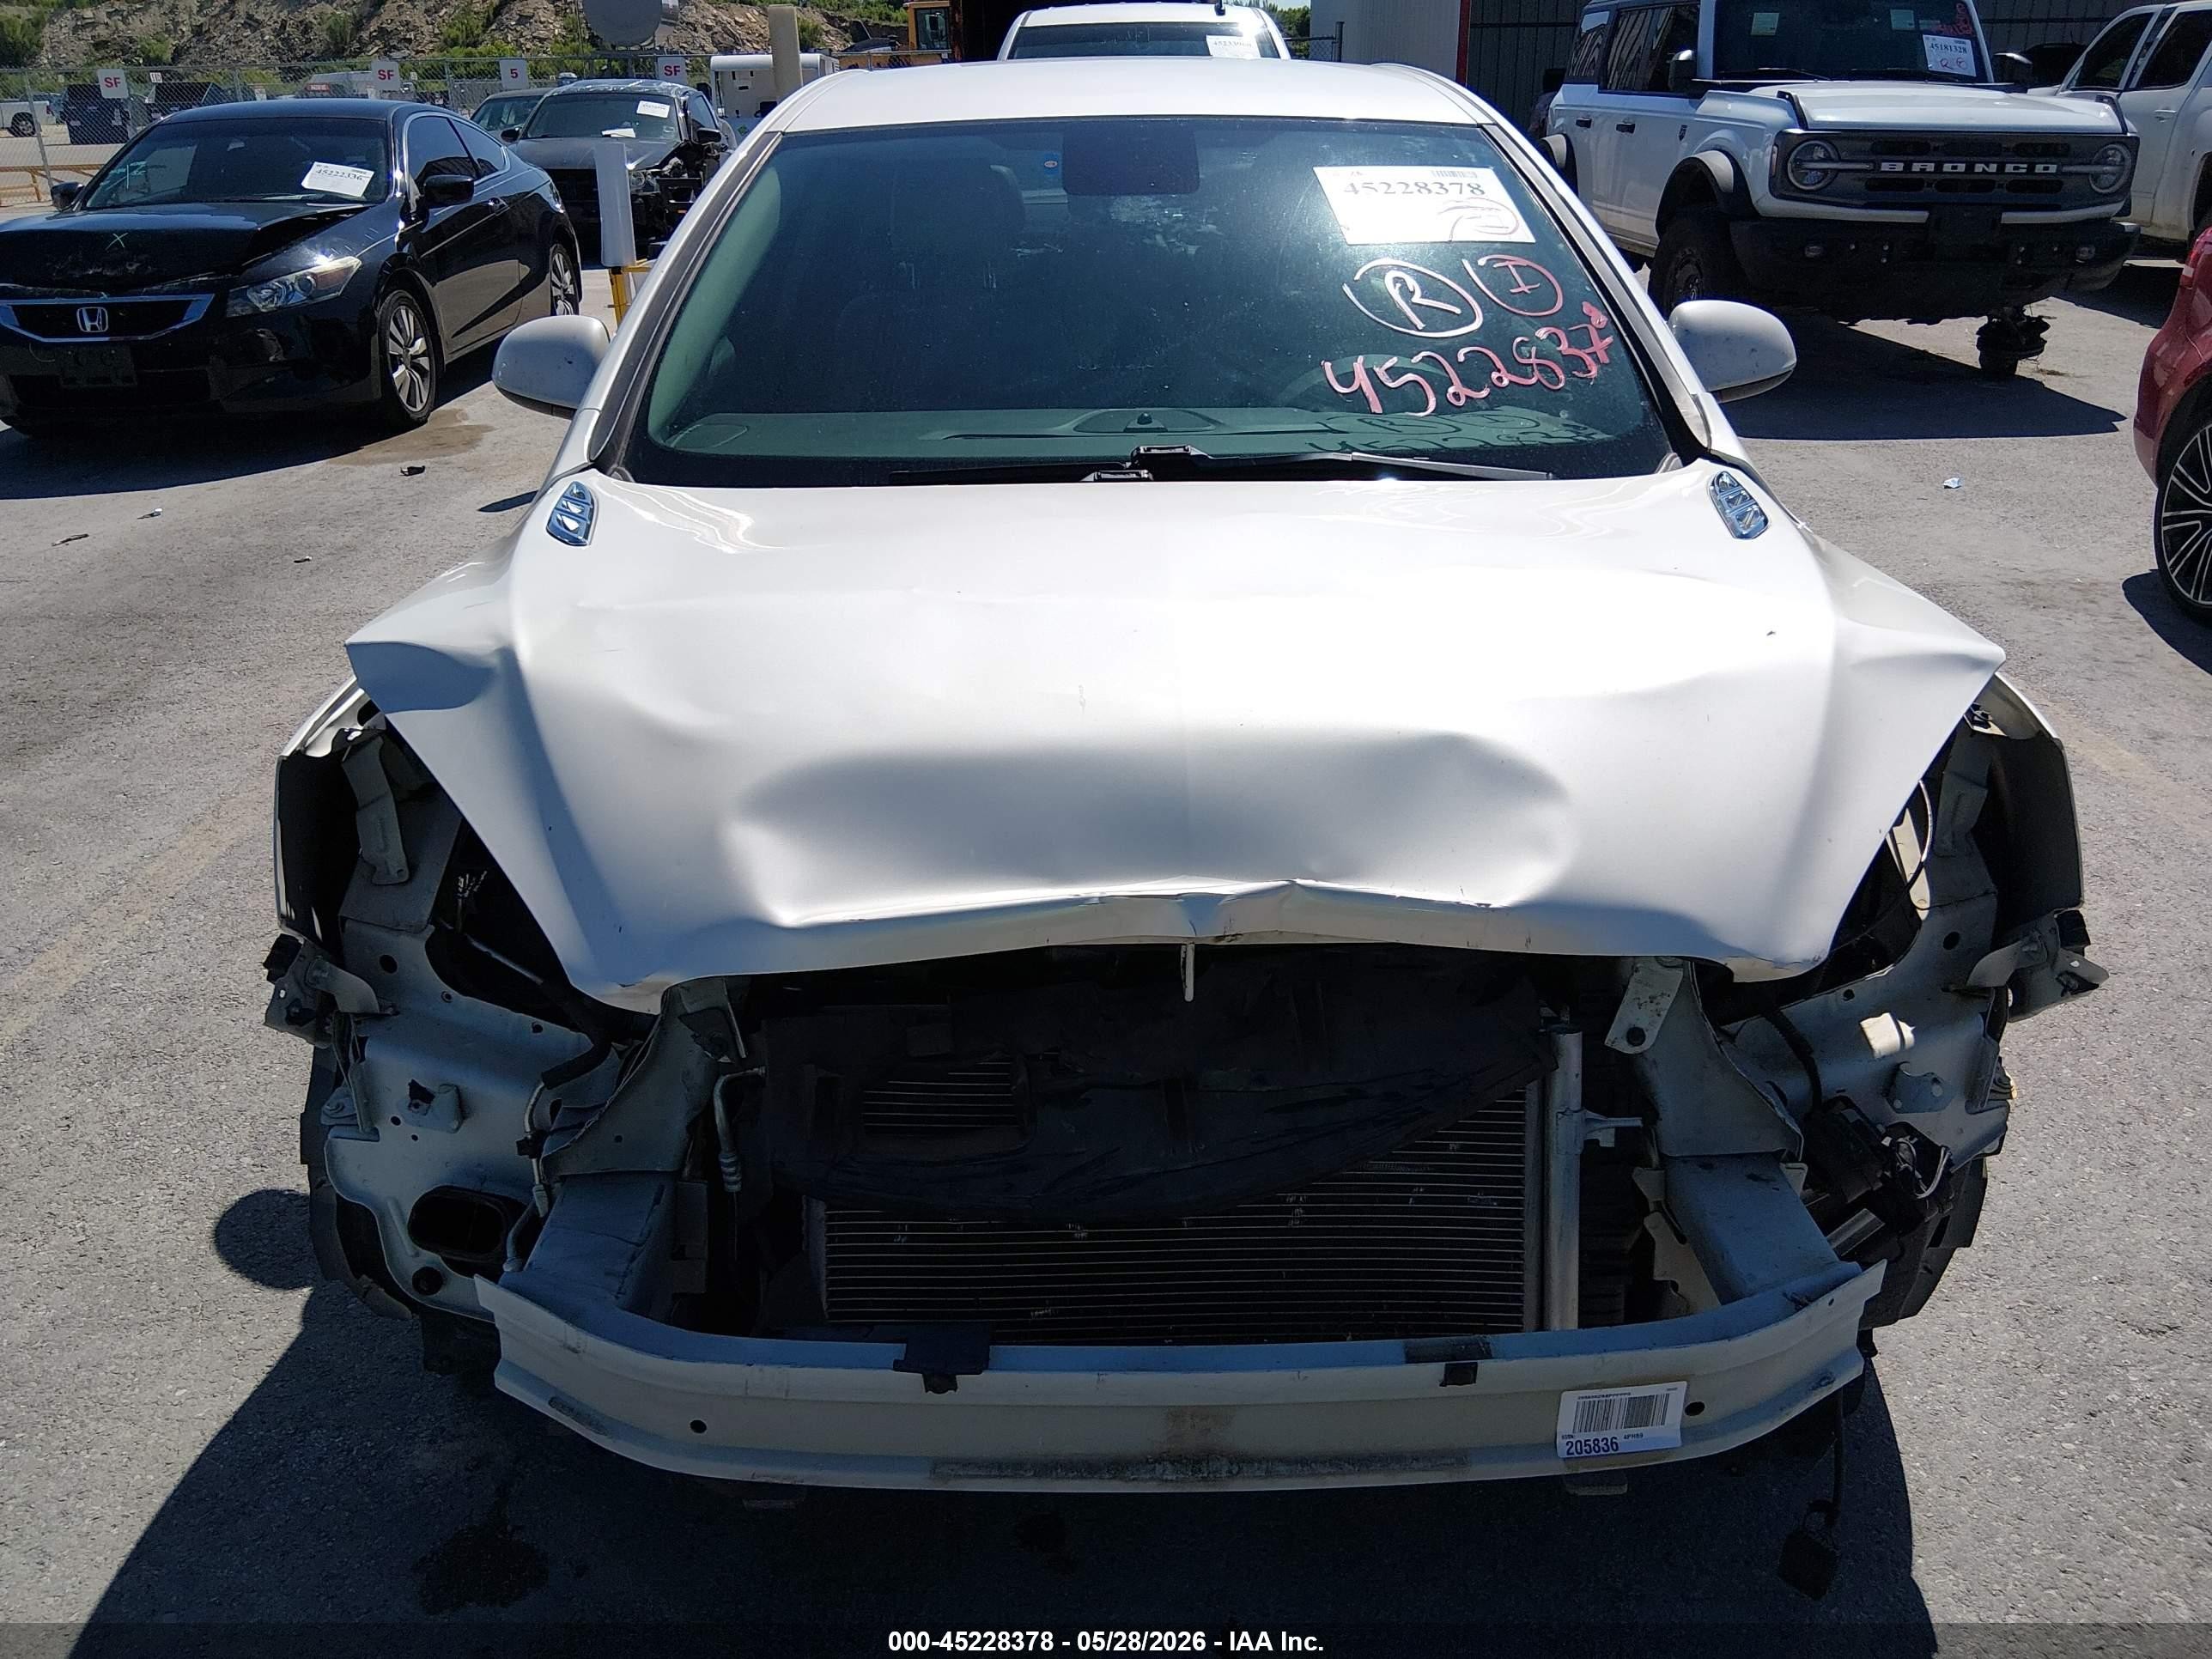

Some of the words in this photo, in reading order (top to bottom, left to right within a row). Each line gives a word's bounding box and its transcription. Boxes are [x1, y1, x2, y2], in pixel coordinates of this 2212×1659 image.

[378, 70, 394, 80] SF
[509, 69, 519, 79] 5
[664, 65, 681, 76] SF
[104, 77, 121, 88] SF
[1881, 162, 2057, 173] BRONCO
[1344, 181, 1486, 196] 45228378
[1565, 1436, 1620, 1455] 205836
